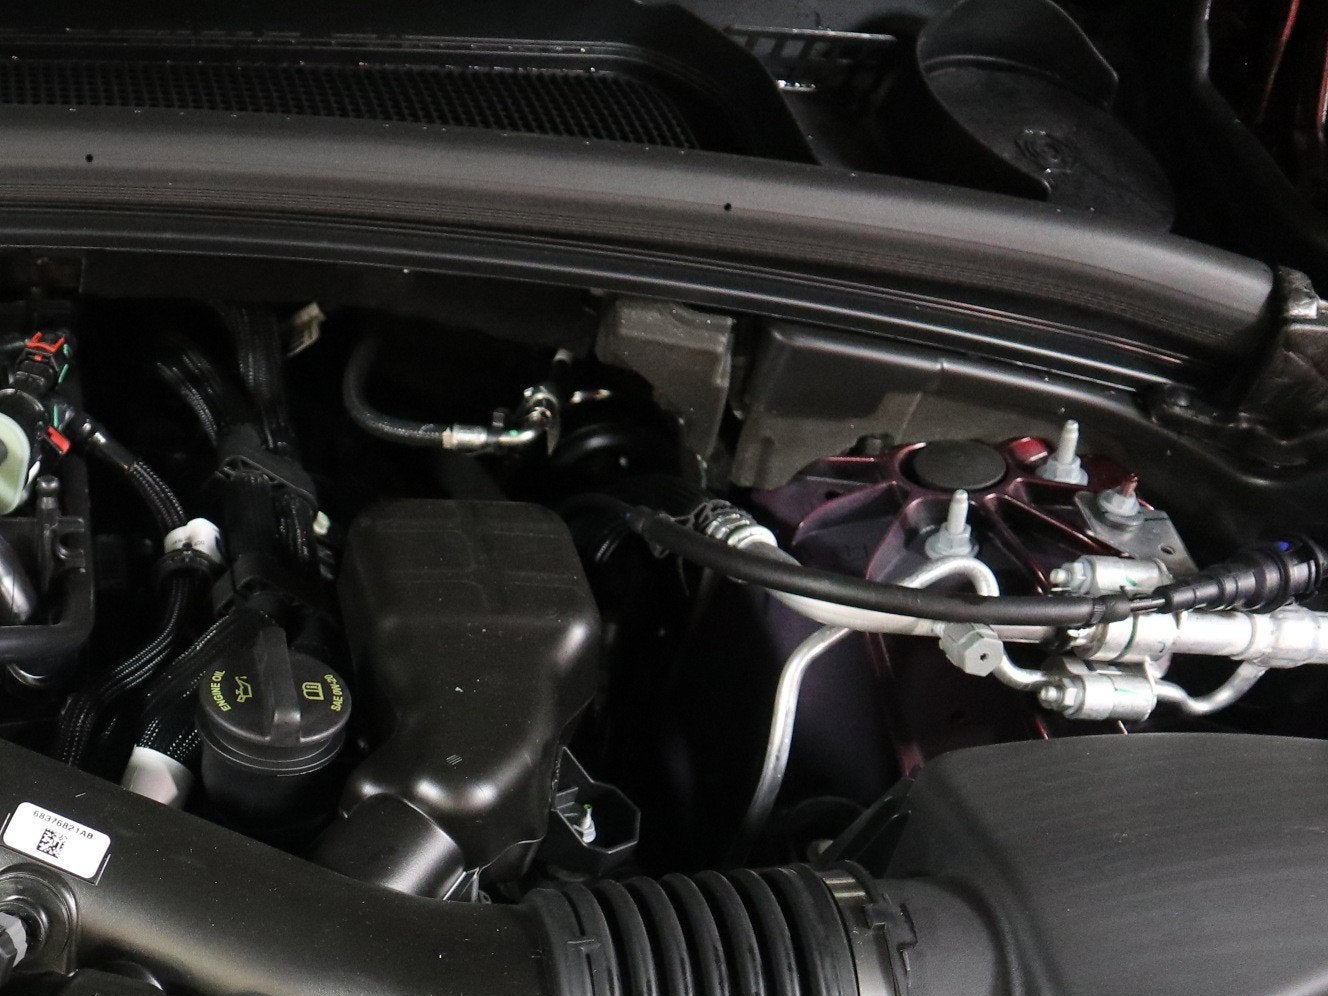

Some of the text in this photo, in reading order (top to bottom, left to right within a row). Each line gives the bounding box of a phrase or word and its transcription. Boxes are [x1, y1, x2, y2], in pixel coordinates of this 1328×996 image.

[210, 670, 232, 712] ENGINE OIL
[330, 695, 344, 712] SAE
[33, 810, 94, 839] 68376821AB
